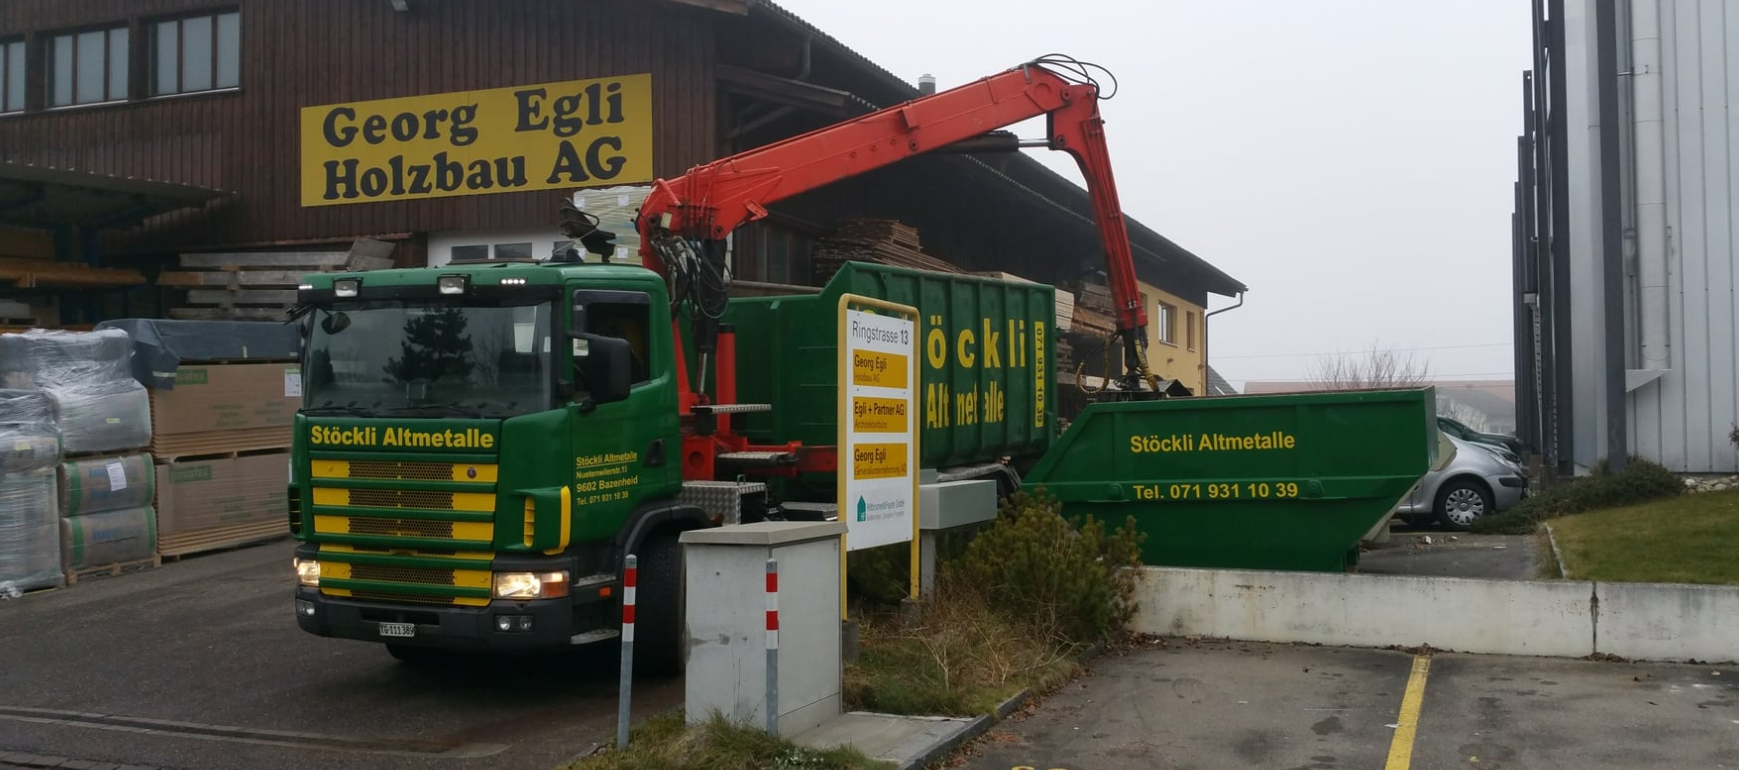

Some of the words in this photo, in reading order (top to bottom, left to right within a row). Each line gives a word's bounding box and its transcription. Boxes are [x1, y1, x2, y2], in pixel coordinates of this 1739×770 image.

[322, 103, 479, 148] Georg
[514, 82, 625, 138] Egli
[323, 151, 528, 201] Holzbau
[546, 136, 627, 184] AG
[852, 321, 898, 344] Ringstrasse
[901, 330, 909, 345] 13
[926, 315, 1026, 369] öckli
[854, 354, 874, 371] Georg
[875, 356, 888, 373] Egli
[873, 373, 880, 383] AG
[854, 402, 867, 417] Egli
[873, 402, 895, 415] Partner
[895, 403, 905, 416] AG
[311, 425, 377, 445] Stöckli
[382, 427, 494, 448] Altmetalle
[1130, 434, 1193, 452] Stöckli
[1198, 431, 1295, 451] Altmetalle
[576, 454, 603, 467] Stöckli
[604, 451, 638, 463] Altmetalle
[854, 448, 874, 464] Georg
[875, 448, 887, 464] Egli
[576, 481, 597, 493] 9602
[598, 475, 638, 490] Bazenheid
[1132, 484, 1164, 499] Tel.
[1170, 484, 1201, 499] 071
[1207, 483, 1240, 498] 931
[1247, 482, 1270, 498] 10
[1275, 482, 1298, 498] 39
[576, 497, 588, 505] Tel.
[589, 495, 600, 504] 071
[601, 493, 612, 502] 931
[614, 492, 621, 500] 10
[621, 490, 629, 499] 39
